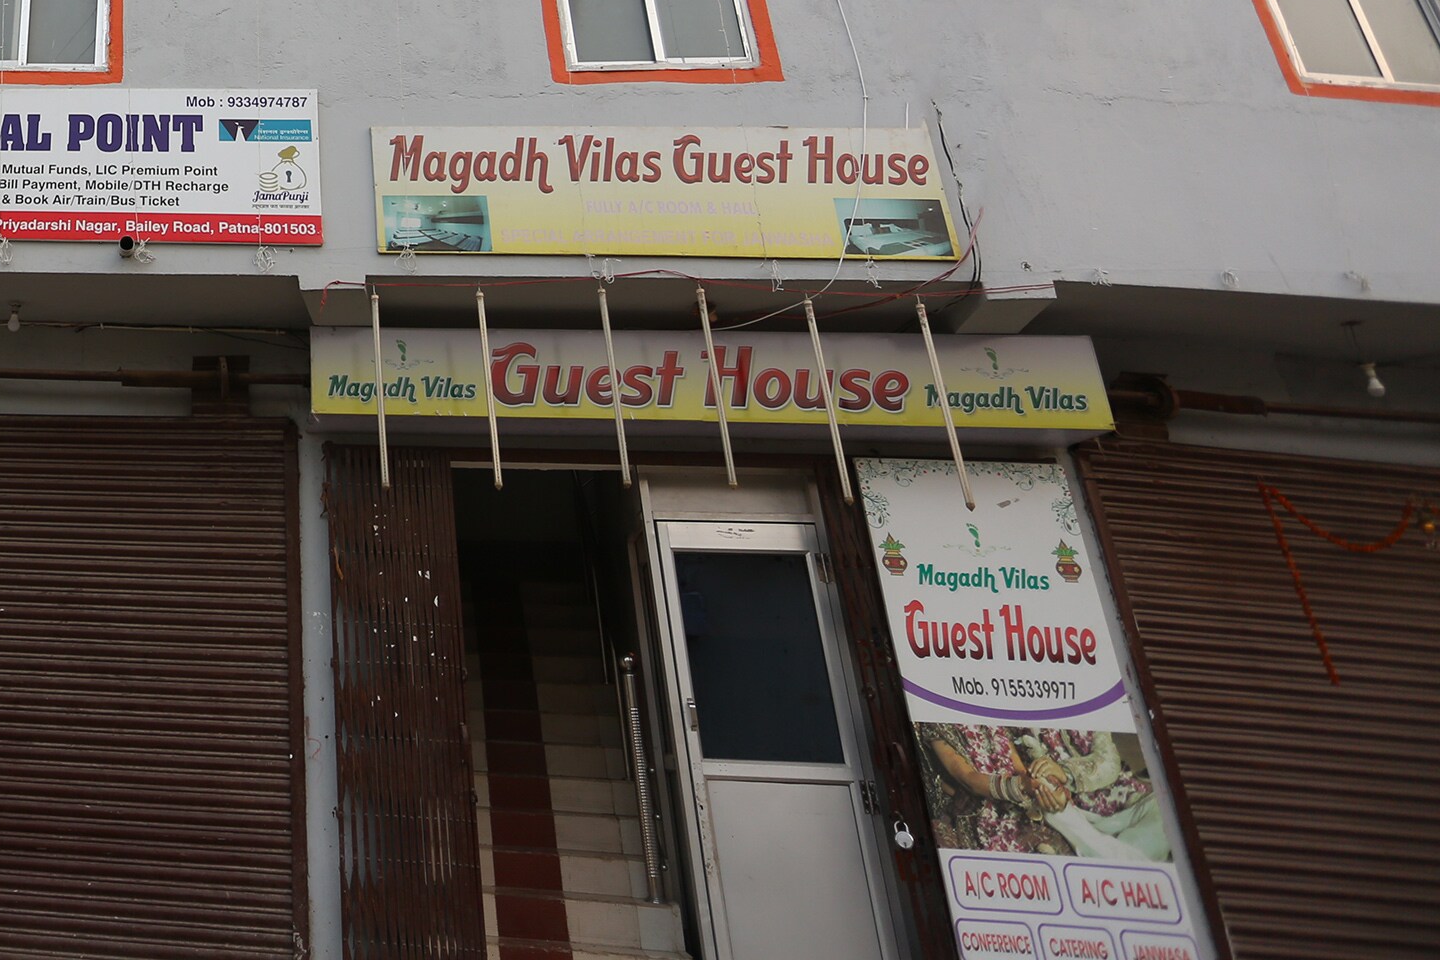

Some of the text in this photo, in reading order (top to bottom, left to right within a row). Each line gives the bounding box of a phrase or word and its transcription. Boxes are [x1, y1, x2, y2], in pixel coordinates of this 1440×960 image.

[186, 95, 215, 108] Mob
[227, 96, 308, 109] 9334974787
[67, 113, 203, 153] POINT
[1, 164, 44, 175] Mutual
[48, 164, 92, 178] Funds,
[96, 165, 117, 176] LIC
[121, 165, 179, 176] Premium
[184, 165, 218, 176] Point
[389, 134, 930, 194] Magadh Vilas Guest House
[22, 179, 81, 193] Payment,
[85, 179, 161, 191] Mobile/DTH
[165, 181, 229, 194] Recharge
[251, 191, 309, 205] JamaPunji
[2, 195, 11, 205] &
[15, 195, 48, 206] Book
[52, 195, 135, 206] Air/Train/Bus
[139, 195, 180, 206] Ticket
[586, 200, 756, 216] FULLY A/C ROOM & HALL
[75, 220, 121, 236] Nagar,
[125, 221, 168, 236] Bailey
[173, 221, 214, 235] Road,
[500, 228, 568, 244] SPECIAL
[704, 229, 737, 246] FOR
[421, 375, 476, 398] Vilas
[491, 342, 910, 412] Guest House
[1025, 386, 1087, 410] Vilas
[916, 563, 1050, 593] Magadh Vilas
[903, 599, 1097, 666] Guest House
[952, 676, 1076, 700] Mob. 9155339977
[965, 871, 1051, 901] A/C ROOM
[1081, 878, 1169, 910] A/C HALL
[961, 931, 1033, 955] CONFERENCE
[1049, 938, 1108, 960] CATERING
